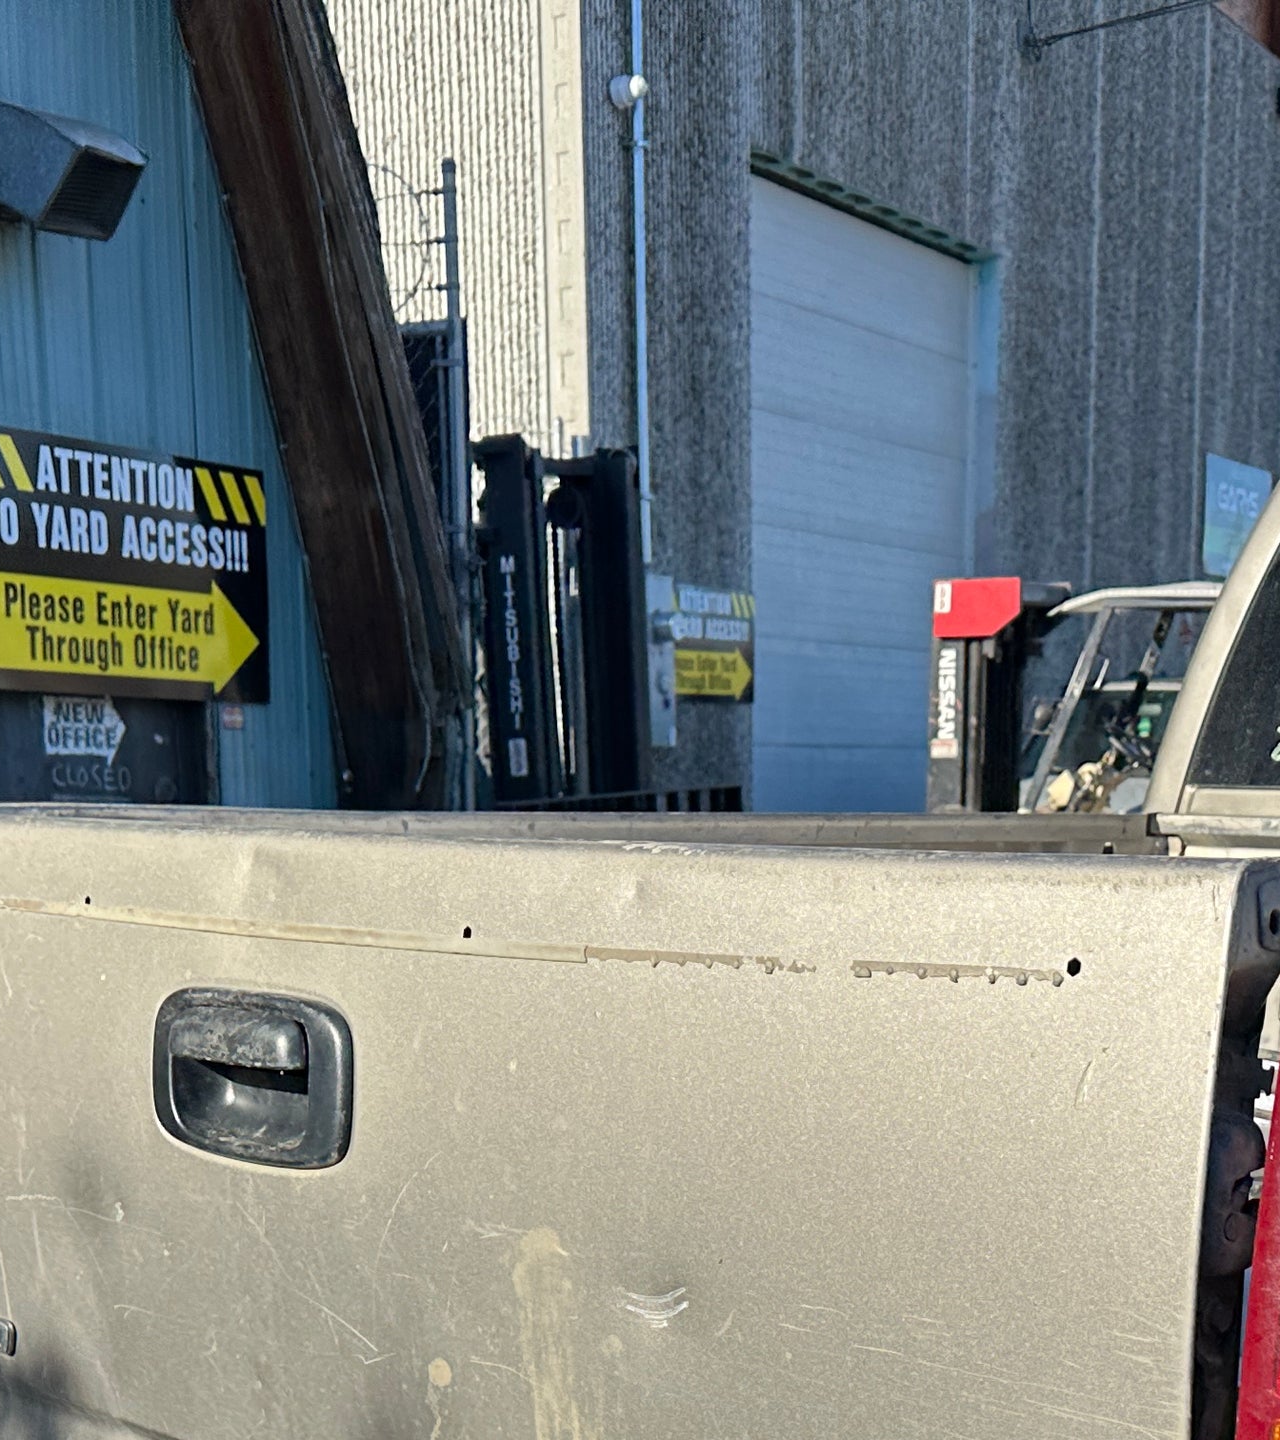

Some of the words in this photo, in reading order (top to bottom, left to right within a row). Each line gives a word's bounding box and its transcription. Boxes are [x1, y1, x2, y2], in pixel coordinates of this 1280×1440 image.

[36, 444, 195, 513] ATTENTION
[31, 502, 109, 556] YARD
[122, 515, 249, 573] ACCESS!!!
[4, 582, 84, 624] Please
[96, 591, 158, 630] Enter
[167, 600, 215, 636] Yard
[26, 625, 123, 672] Through
[134, 633, 200, 672] Office
[499, 555, 524, 731] MITSUBISHI
[55, 702, 105, 725] NEW
[937, 647, 957, 740] NISSAN
[47, 721, 118, 750] OFFICE
